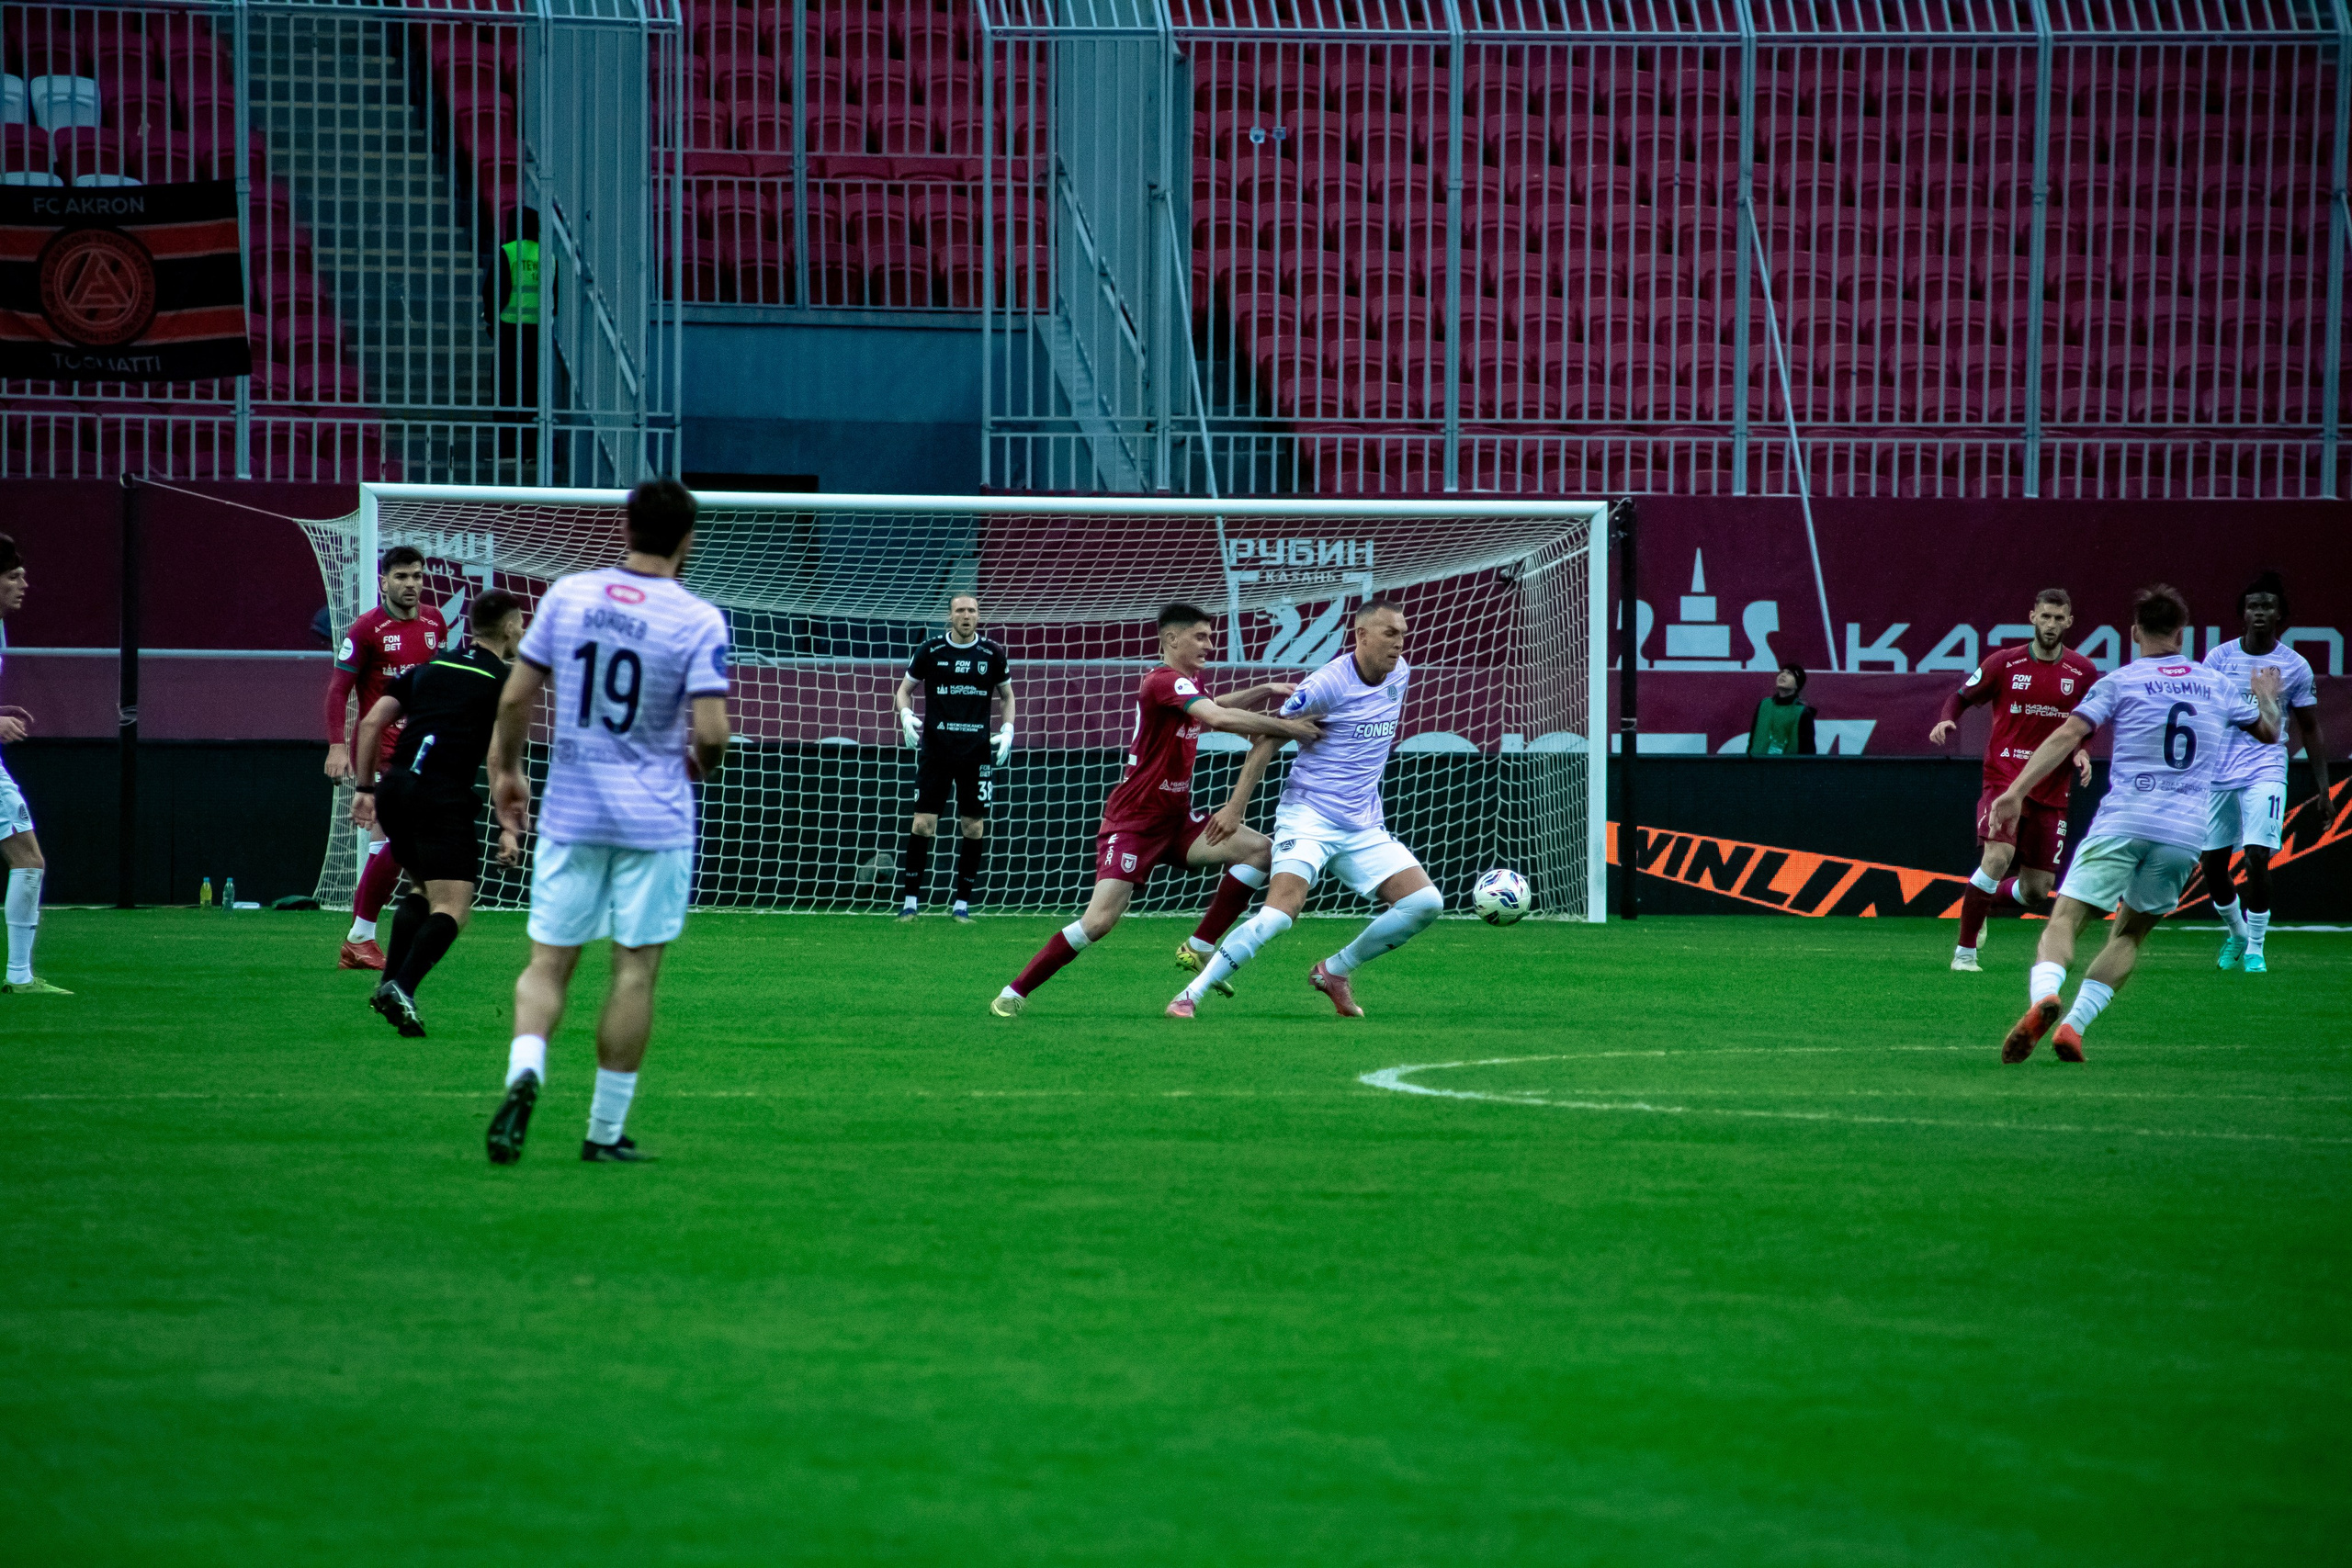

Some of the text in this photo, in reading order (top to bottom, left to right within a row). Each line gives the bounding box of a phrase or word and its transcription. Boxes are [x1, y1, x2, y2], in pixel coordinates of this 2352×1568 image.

[33, 196, 145, 214] FC AKRON
[1228, 537, 1374, 567] РУБИН
[1265, 570, 1336, 583] КАЗАНЬ
[383, 635, 401, 644] FON
[384, 643, 402, 652] BET
[573, 640, 642, 734] 19
[2012, 673, 2032, 682] FON
[2012, 682, 2031, 690] BET
[2143, 681, 2211, 701] КУЗЬМИН
[2025, 703, 2059, 712] КАЗАНЬ
[2163, 701, 2199, 771] 6
[978, 781, 993, 801] 38
[2268, 795, 2280, 820] 11
[2052, 840, 2064, 864] 2
